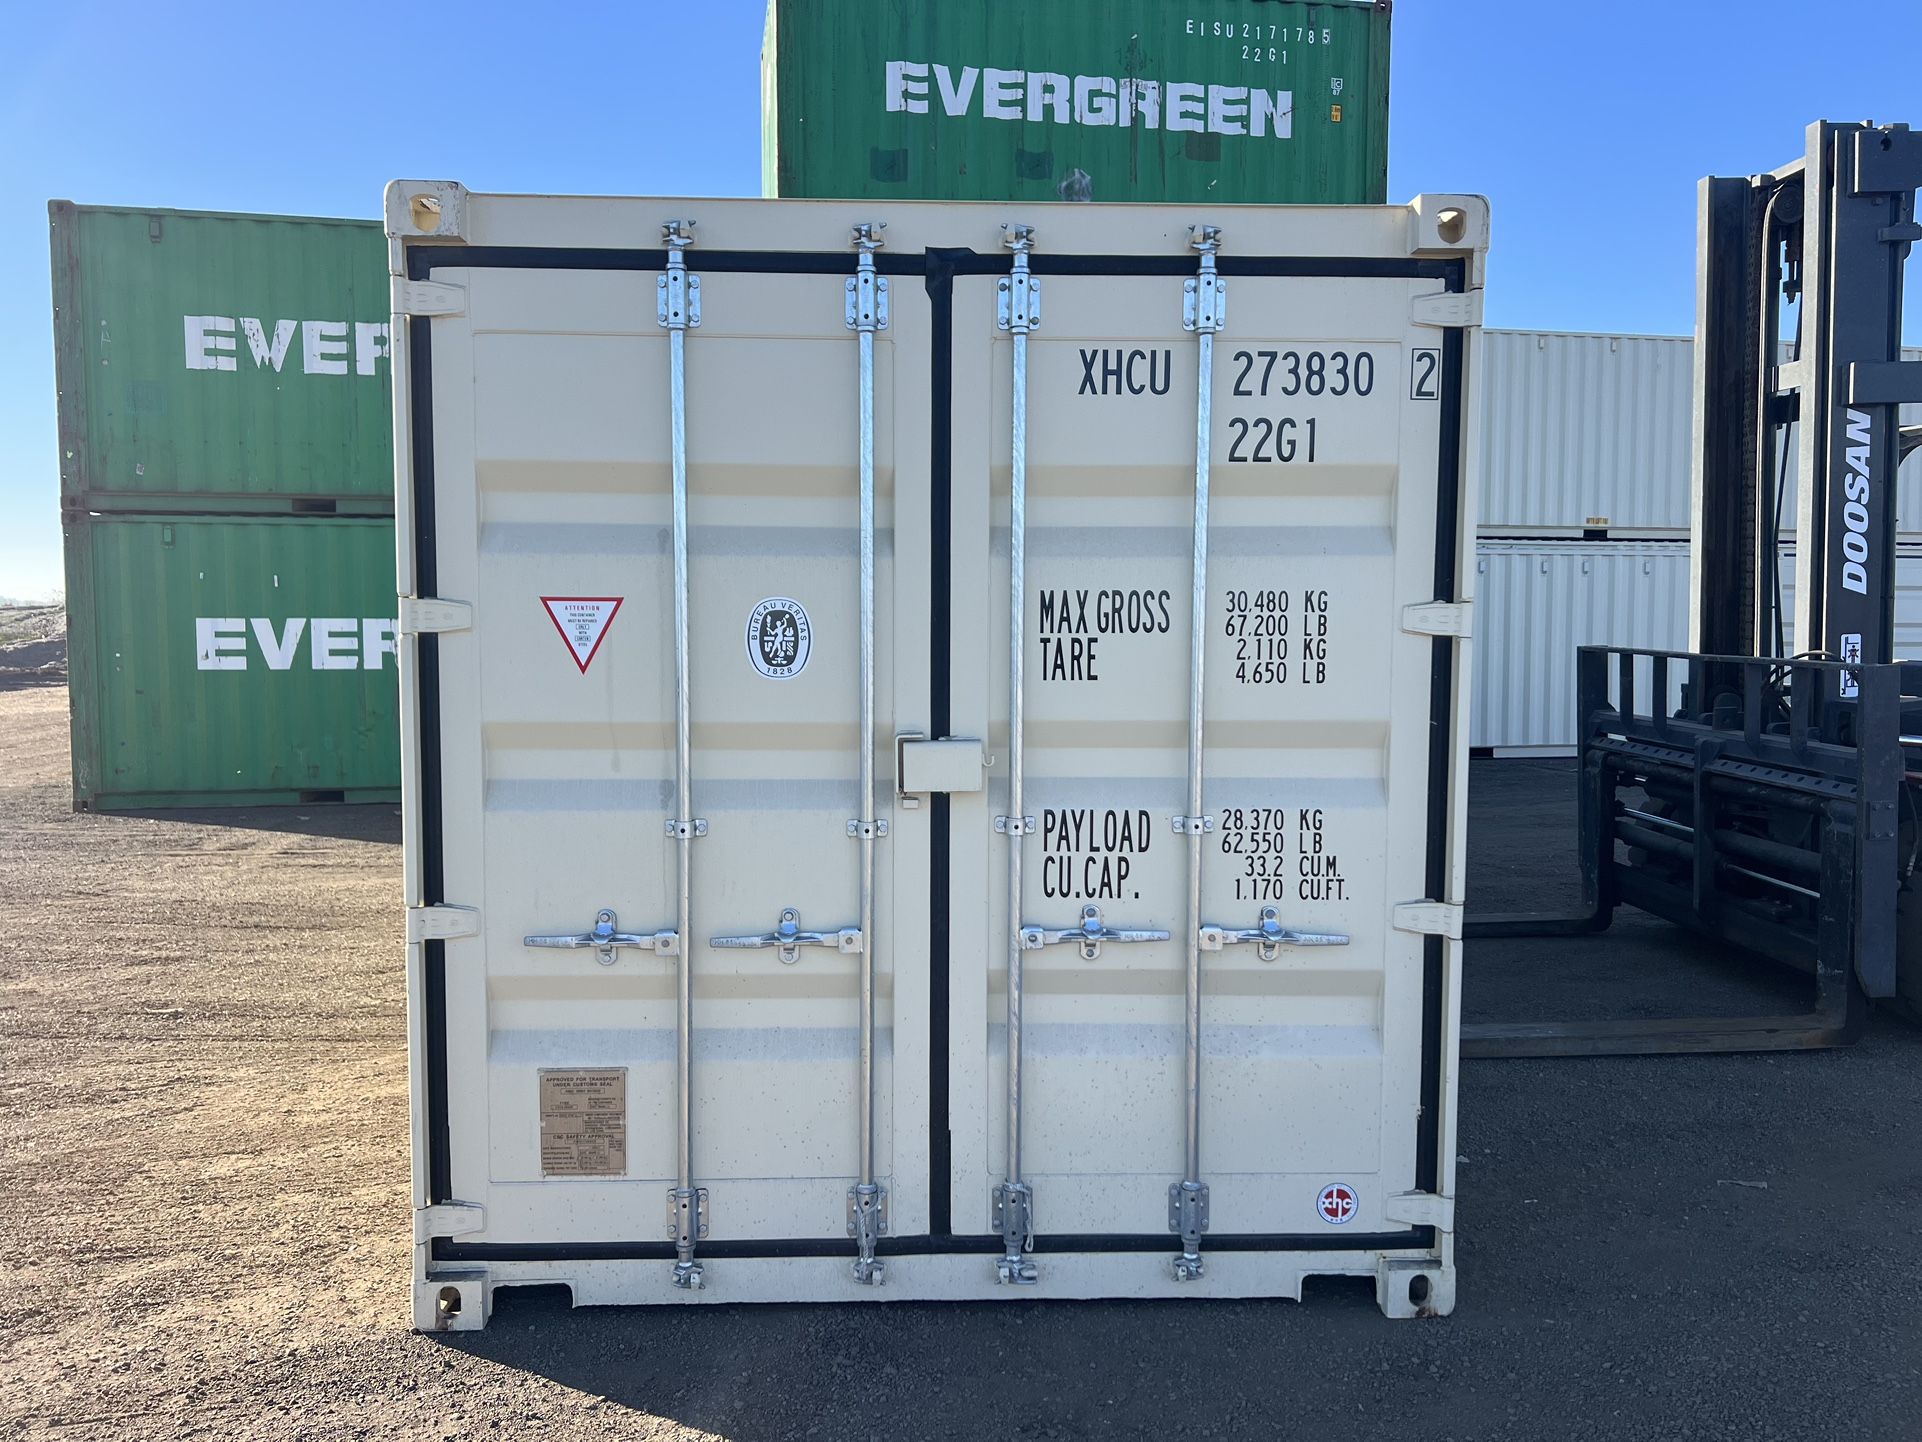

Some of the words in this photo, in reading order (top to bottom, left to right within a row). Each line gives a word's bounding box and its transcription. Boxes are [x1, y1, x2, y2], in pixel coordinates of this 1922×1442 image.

[1242, 45, 1287, 65] 22G1
[885, 59, 1292, 139] EVERGREEN
[1078, 348, 1171, 396] XHCU
[1233, 350, 1374, 397] 273830
[1228, 417, 1316, 463] 22G1
[1842, 408, 1871, 596] DOOSAN
[1039, 589, 1089, 634] MAX
[1096, 589, 1171, 634] GROSS
[1225, 590, 1289, 613] 30,480
[1304, 590, 1328, 613] KG
[751, 602, 777, 641] BUREAU
[781, 602, 807, 641] VERITAS
[1225, 614, 1288, 637] 67,200
[1304, 614, 1328, 637] LB
[1039, 637, 1099, 681] TARE
[1236, 638, 1288, 660] 2,110
[1303, 638, 1327, 660] KG
[766, 666, 793, 675] 1828
[1235, 661, 1287, 684] 4,650
[1302, 661, 1326, 684] LB
[1043, 809, 1151, 853] PAYLOAD
[1221, 808, 1284, 831] 28,370
[1299, 808, 1323, 831] KG
[1221, 832, 1284, 854] 62,550
[1299, 832, 1323, 854] LB
[1043, 855, 1139, 899] CU.CAP.
[1244, 855, 1284, 877] 33.2
[1299, 855, 1341, 878] CU.M.
[1235, 878, 1283, 901] 1,170
[1298, 878, 1349, 901] CU.FT.
